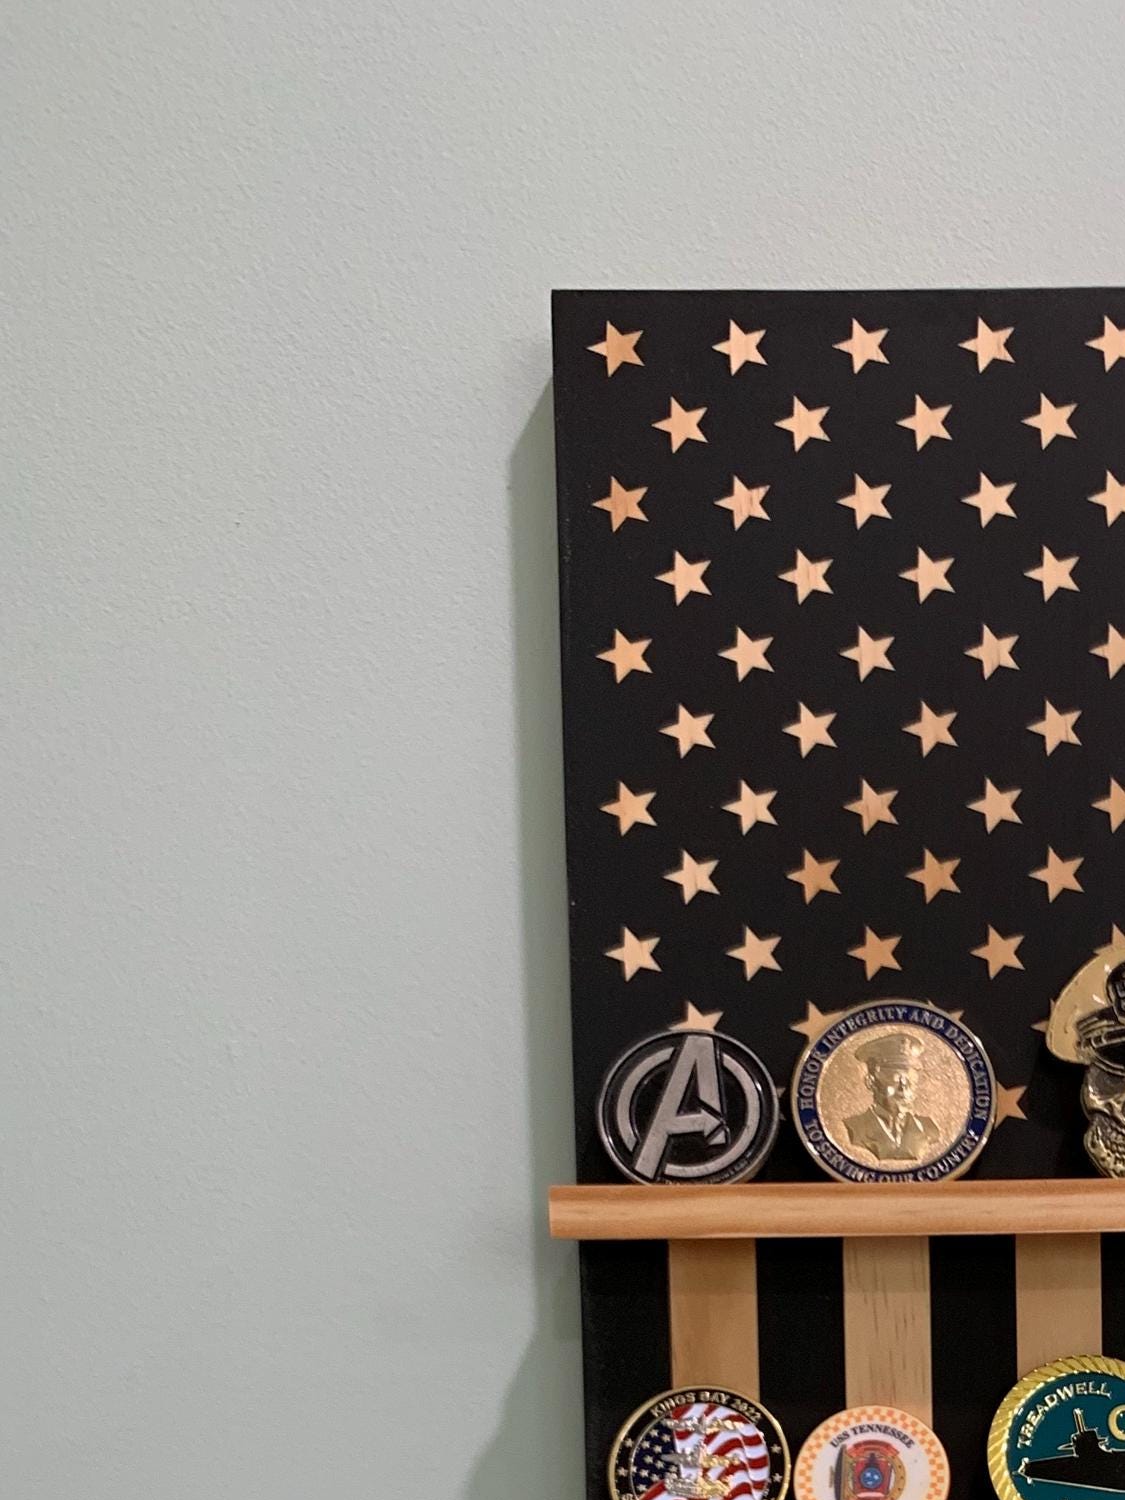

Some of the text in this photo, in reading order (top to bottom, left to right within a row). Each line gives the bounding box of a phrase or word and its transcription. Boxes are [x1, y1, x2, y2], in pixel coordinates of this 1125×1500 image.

[801, 1006, 992, 1120] HONOR INTEGRITY AND DEDICATION
[805, 1118, 823, 1142] TO
[816, 1139, 876, 1183] SERVING
[917, 1129, 980, 1182] COUNTRY
[650, 1391, 696, 1419] KINGS
[700, 1391, 731, 1403] BAY
[829, 1423, 915, 1449] USS TENNESSEE
[1017, 1380, 1112, 1449] TREADWELL
